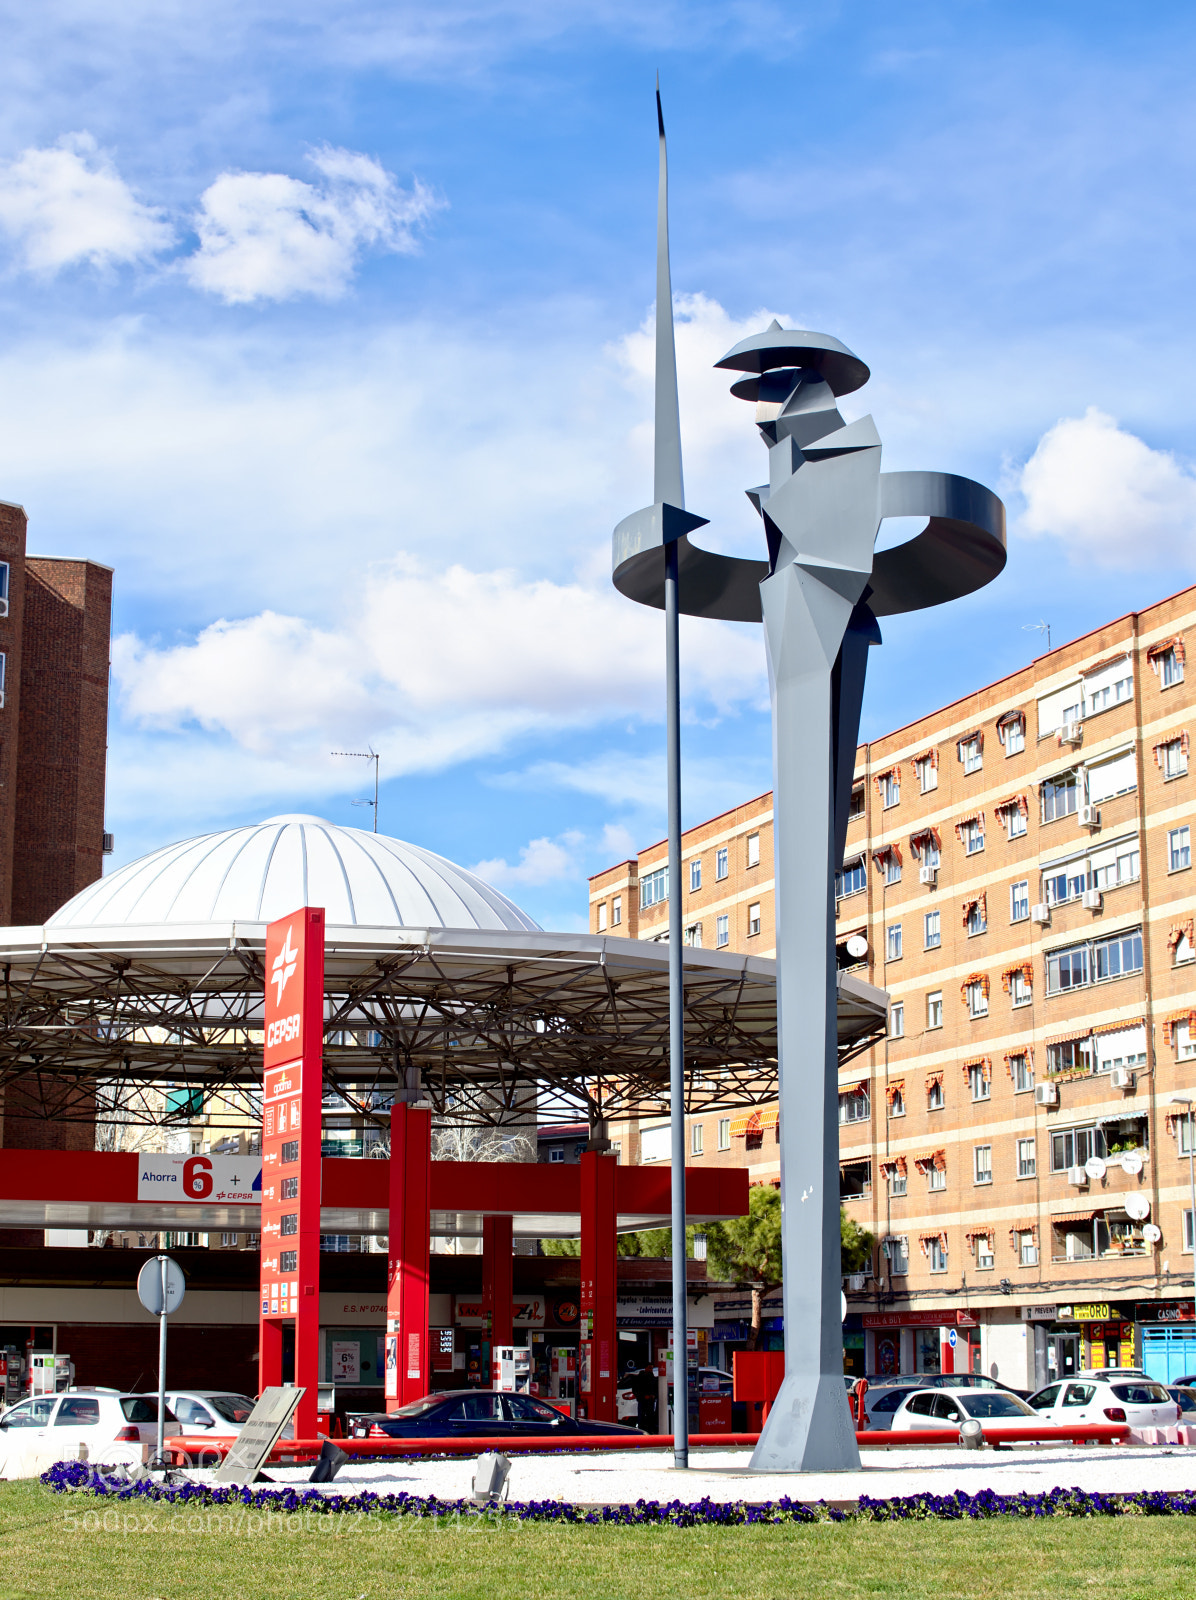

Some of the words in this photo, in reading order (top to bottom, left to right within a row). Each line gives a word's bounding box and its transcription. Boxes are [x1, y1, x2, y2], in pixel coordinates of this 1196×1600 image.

[267, 1014, 300, 1048] CEPSA
[142, 1172, 177, 1182] Ahorra
[343, 1305, 358, 1313] E.S.
[514, 1301, 544, 1321] 24h
[1090, 1304, 1108, 1318] ORO
[1157, 1309, 1181, 1320] CASINO
[865, 1316, 881, 1325] SELL
[889, 1315, 901, 1324] BUY
